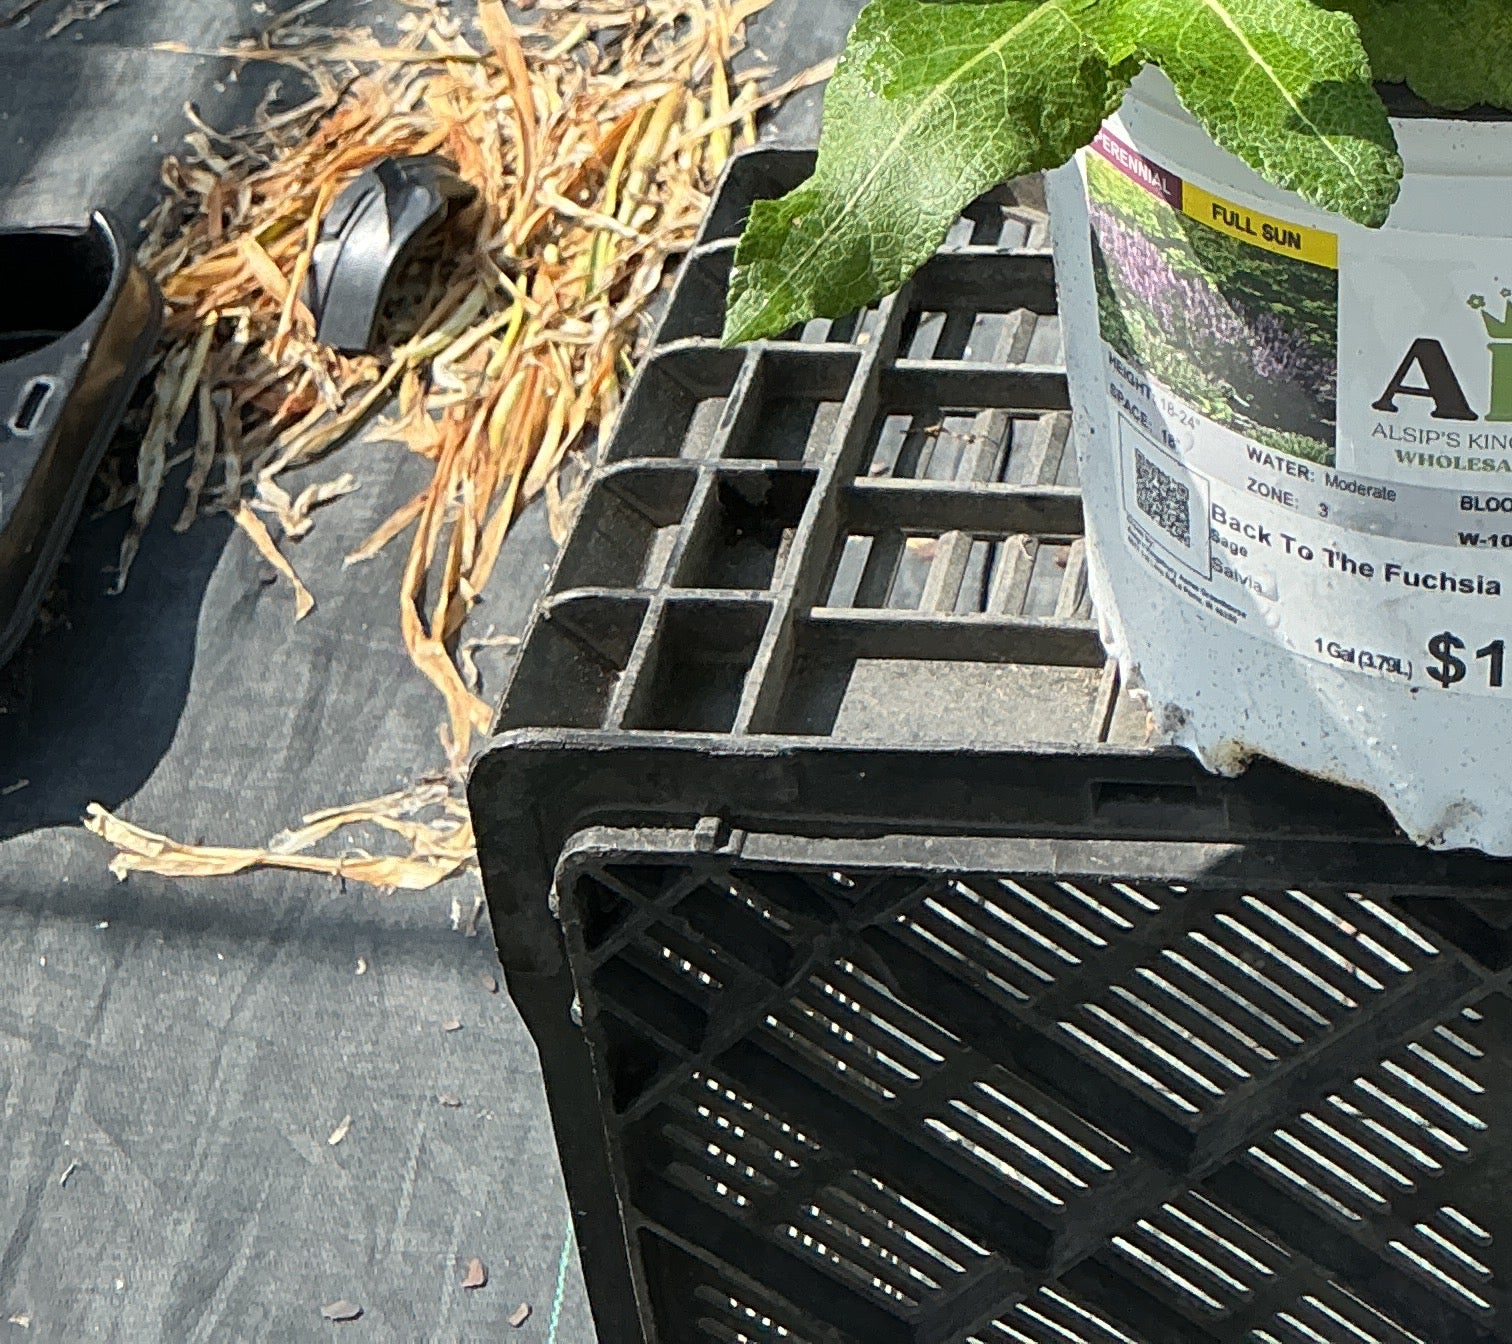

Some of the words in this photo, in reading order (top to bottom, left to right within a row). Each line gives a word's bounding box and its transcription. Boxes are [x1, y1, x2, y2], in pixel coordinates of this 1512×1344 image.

[1212, 203, 1257, 237] FULL
[1261, 223, 1302, 251] SUN
[1371, 422, 1461, 448] ALSIP'S
[1246, 444, 1316, 483] WATER:
[1325, 472, 1397, 503] Moderate
[1246, 476, 1299, 510] ZONE:
[1318, 502, 1330, 519] 3
[1210, 527, 1249, 558] Sage
[1211, 502, 1273, 548] Back
[1280, 533, 1315, 562] To
[1322, 547, 1375, 579] The
[1384, 562, 1501, 597] Fuchsia
[1210, 556, 1264, 594] Salvia
[1314, 637, 1325, 654] 1
[1327, 641, 1355, 664] Gal
